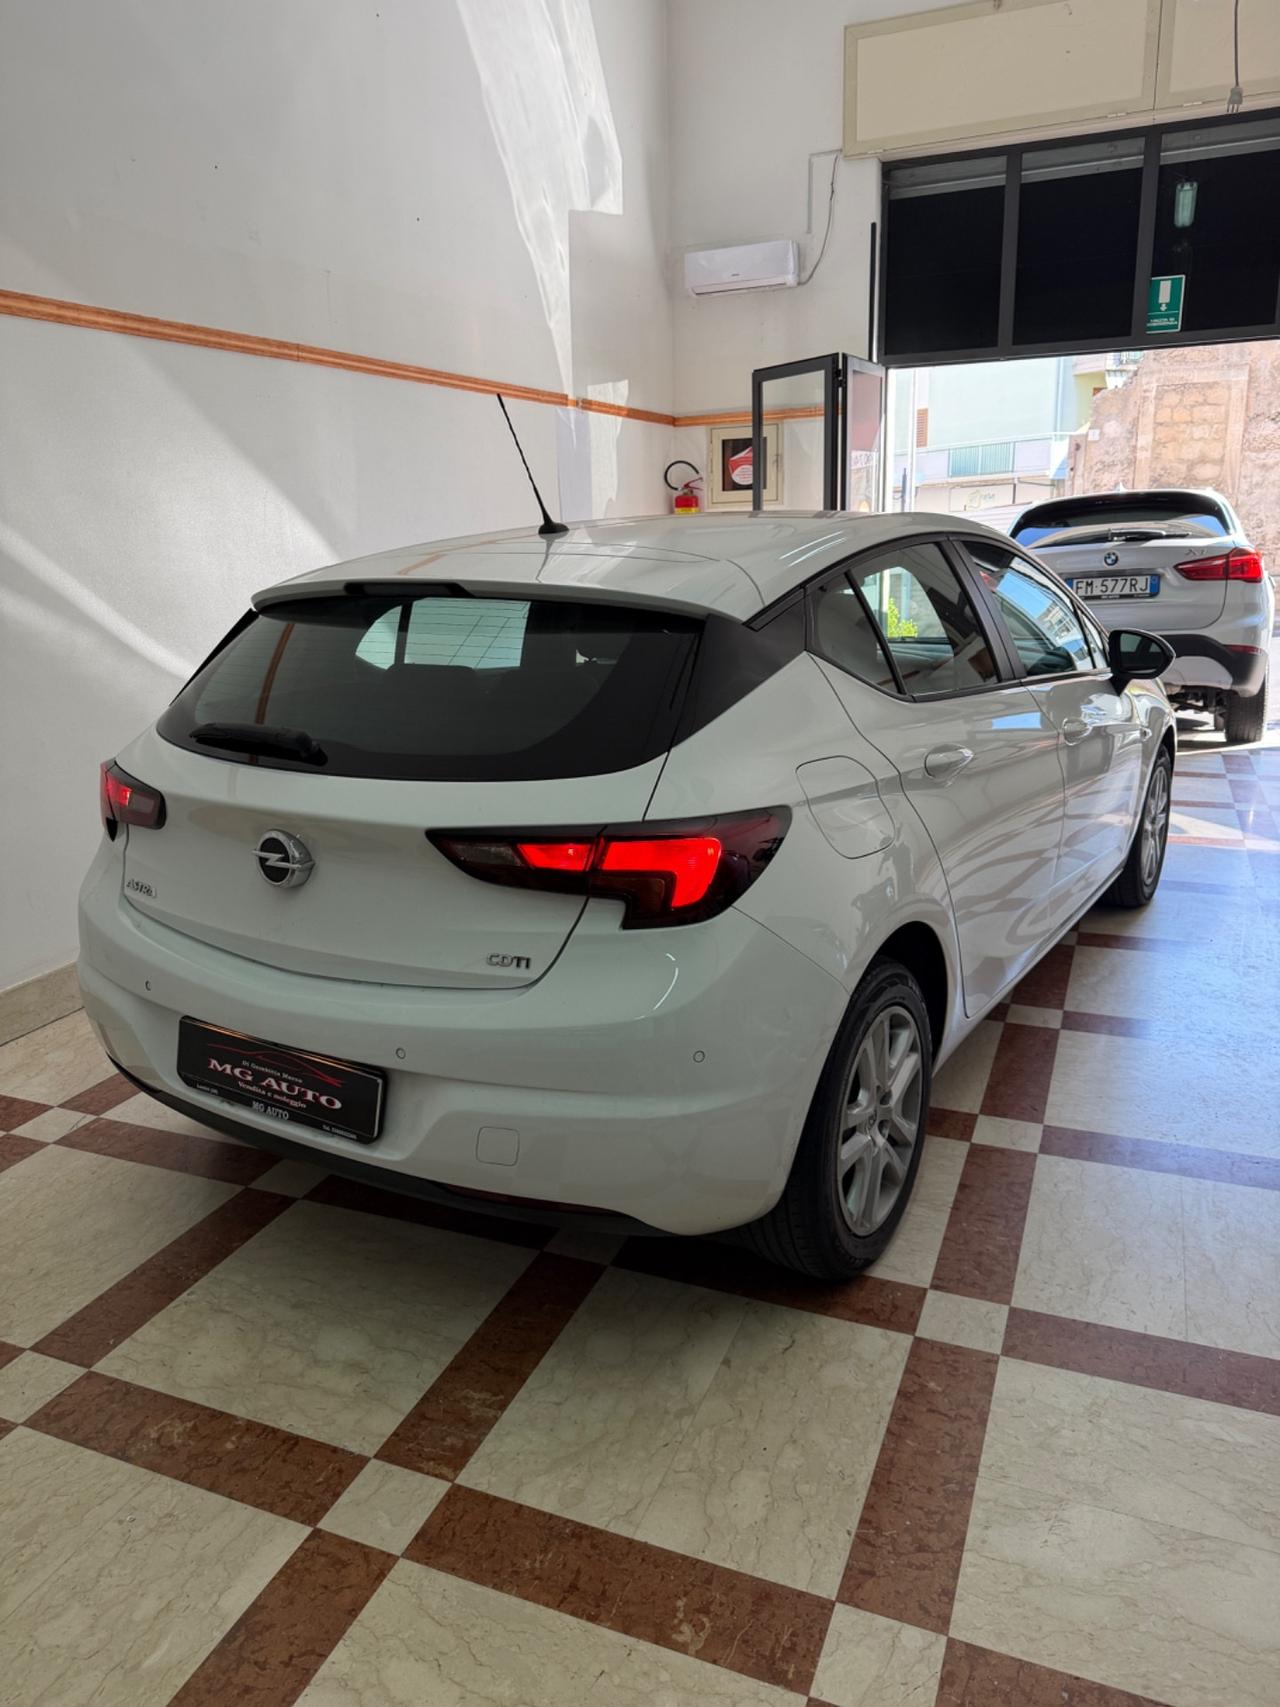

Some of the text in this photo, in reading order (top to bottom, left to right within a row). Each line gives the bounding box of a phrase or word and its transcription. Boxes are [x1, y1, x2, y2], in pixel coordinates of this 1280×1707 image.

[1075, 576, 1149, 595] FM 577RJ
[126, 879, 157, 898] ASTRA
[487, 953, 531, 970] CDTI
[208, 1058, 342, 1110] MG AUTO
[238, 1081, 266, 1095] Vendita
[273, 1094, 307, 1109] noleggio
[252, 1100, 289, 1120] MG AUTO
